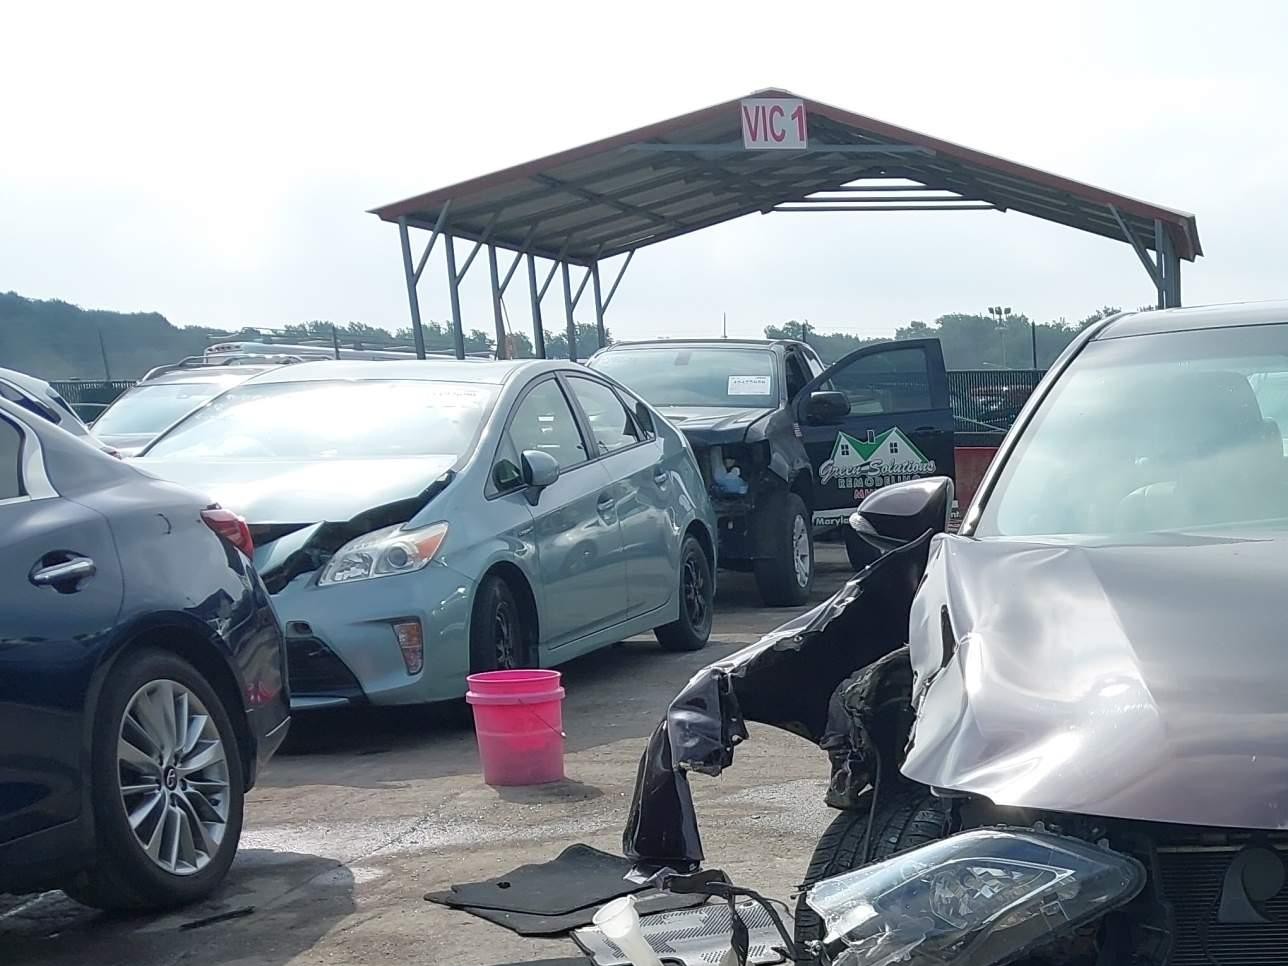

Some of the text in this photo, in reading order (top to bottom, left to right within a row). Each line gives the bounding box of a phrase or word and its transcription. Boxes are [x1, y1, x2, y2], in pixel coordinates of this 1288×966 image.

[742, 104, 805, 142] VIC 1
[819, 458, 937, 485] Green Solutions
[815, 515, 850, 527] Maryla
